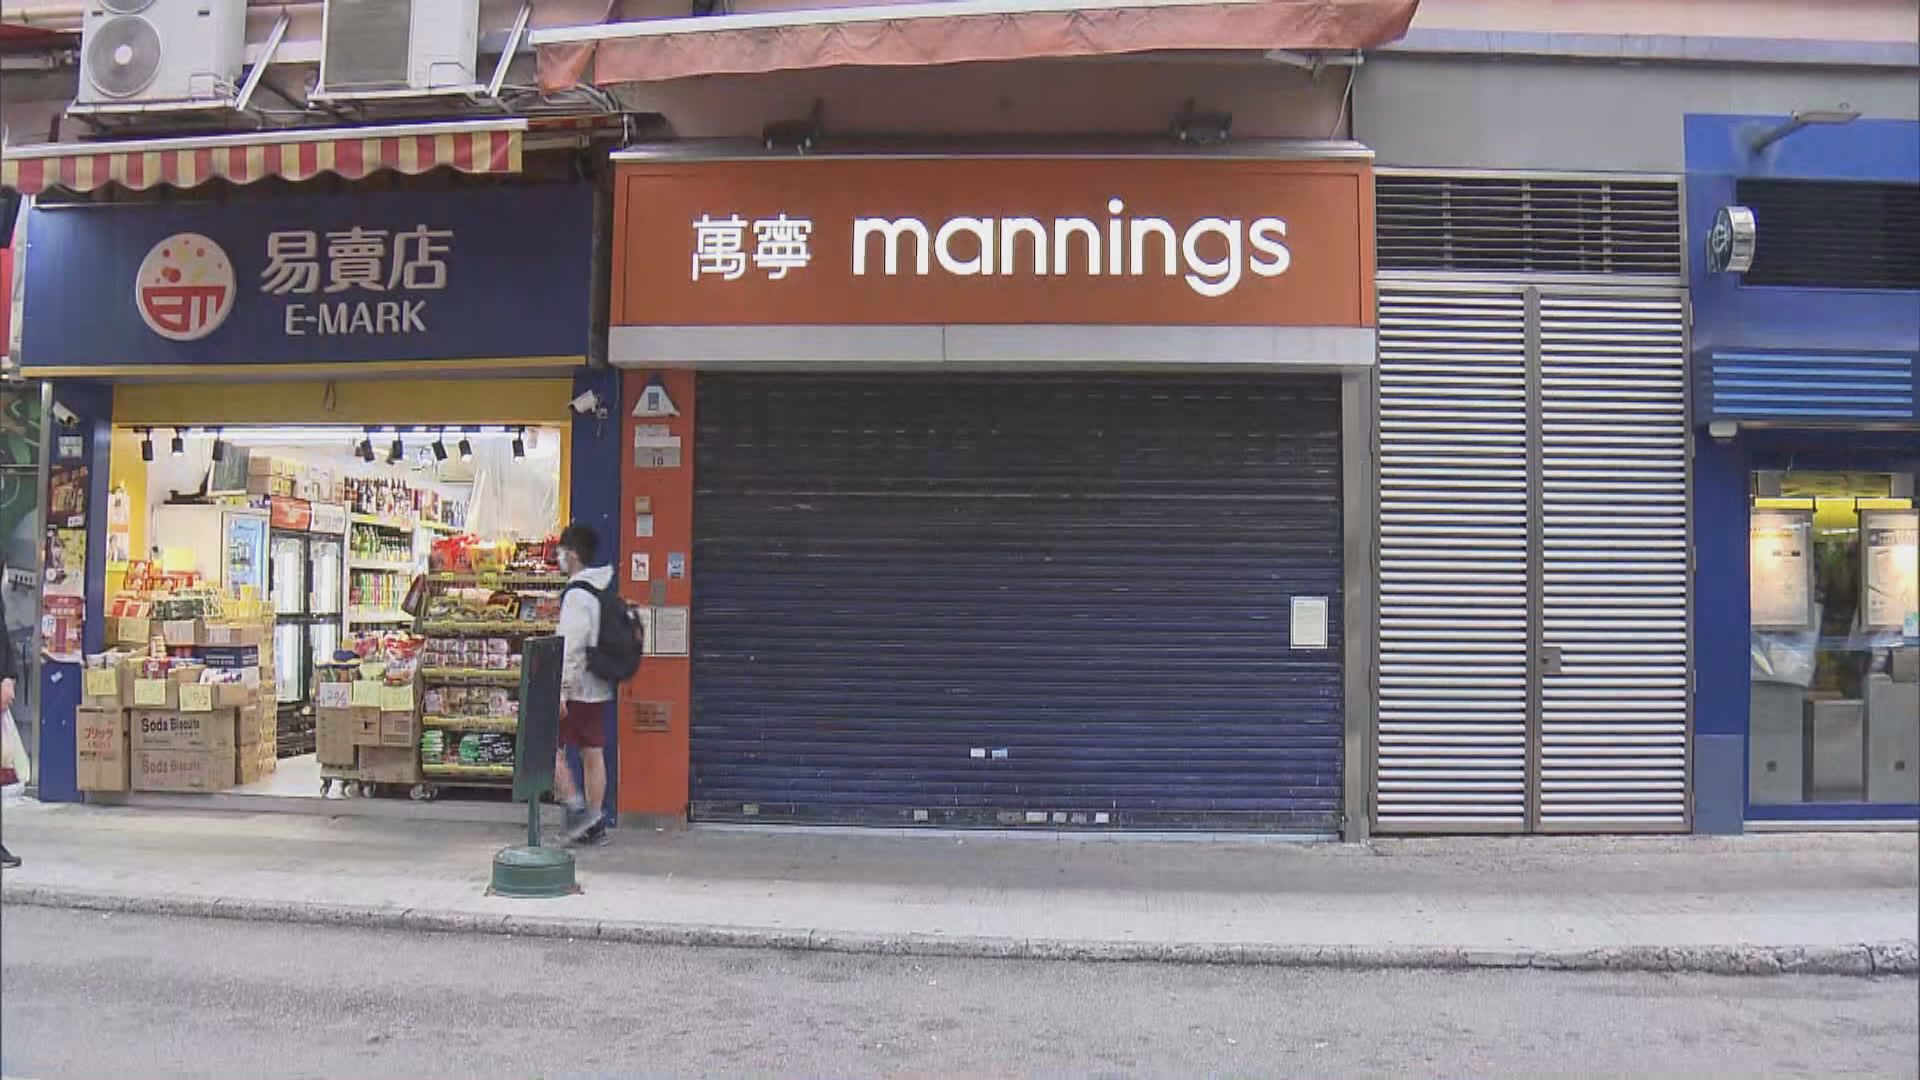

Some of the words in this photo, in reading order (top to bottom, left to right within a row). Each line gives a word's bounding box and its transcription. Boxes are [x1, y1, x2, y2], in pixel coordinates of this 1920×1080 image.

[260, 224, 453, 295] 易賣店
[691, 213, 813, 281] 萬寧
[852, 197, 1291, 297] mannings
[285, 299, 427, 335] E-MARK
[141, 717, 168, 733] Soda
[142, 759, 168, 774] Soda
